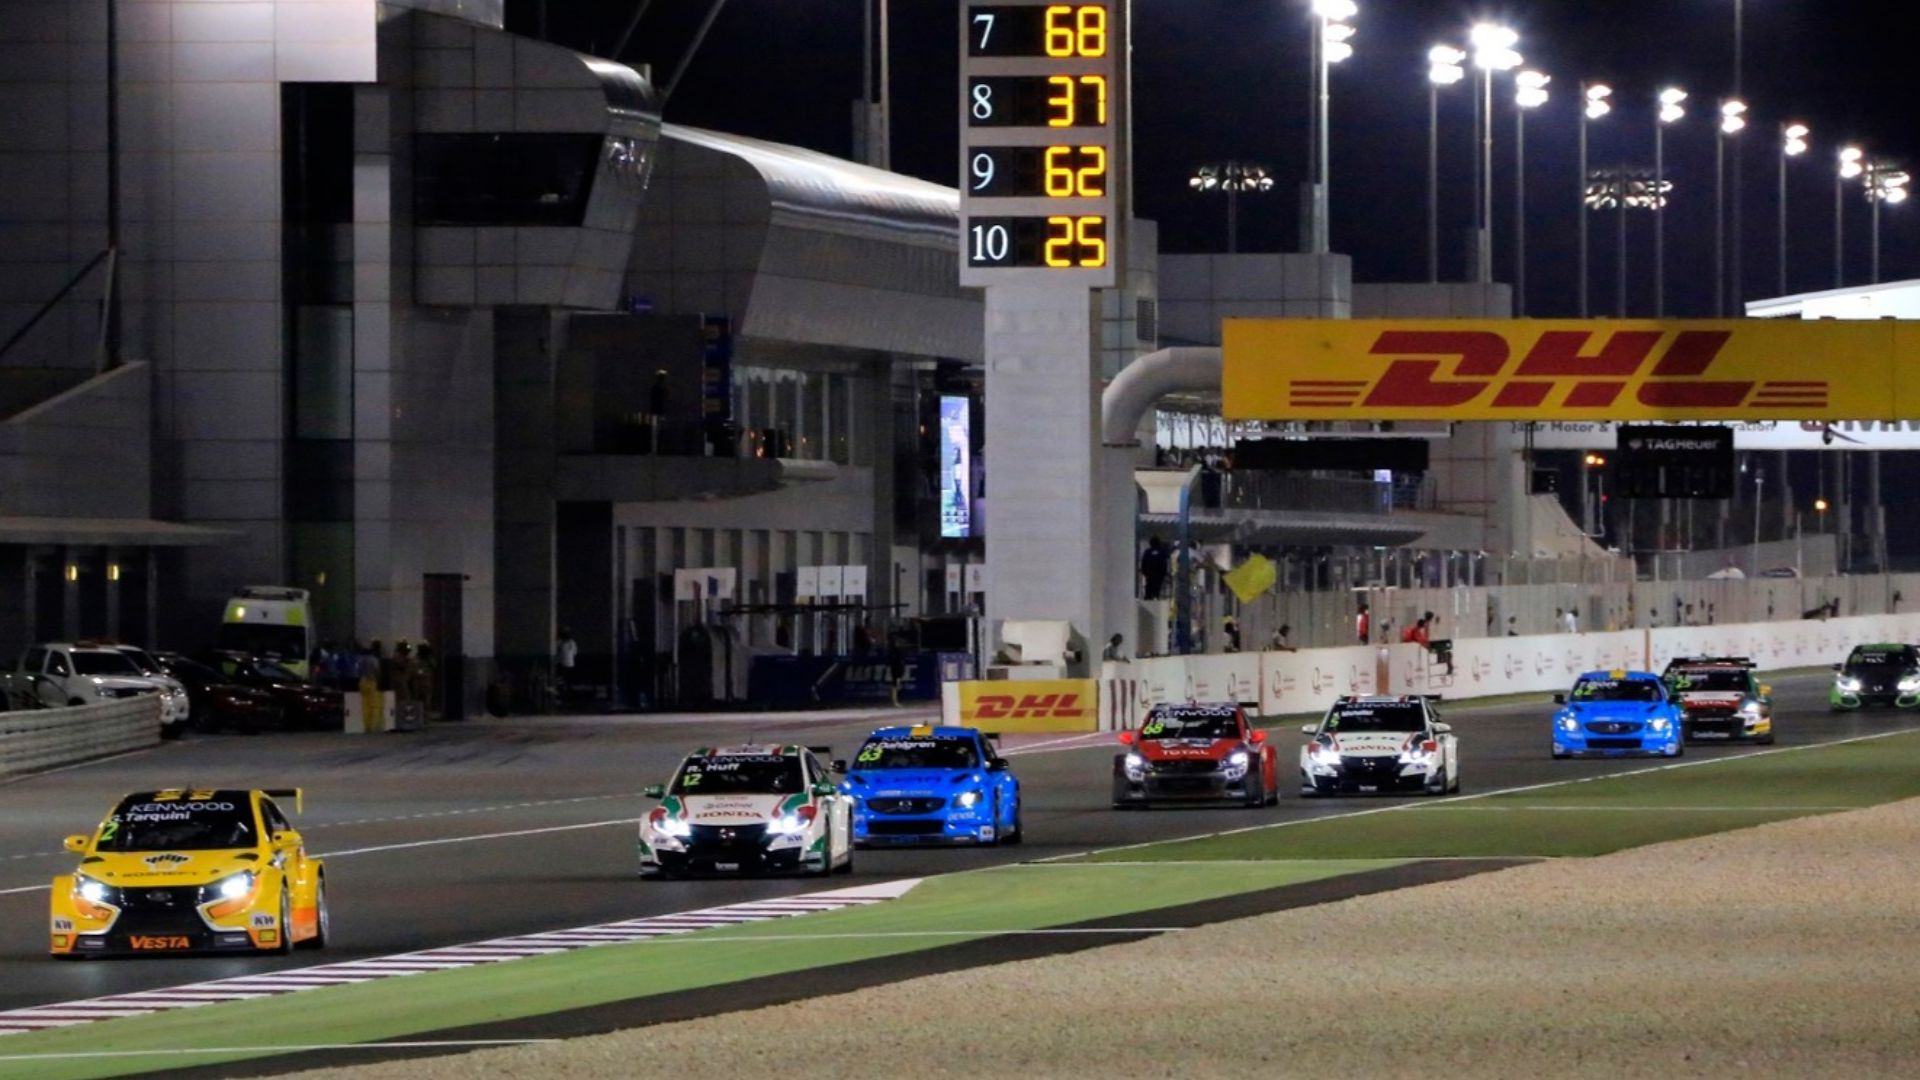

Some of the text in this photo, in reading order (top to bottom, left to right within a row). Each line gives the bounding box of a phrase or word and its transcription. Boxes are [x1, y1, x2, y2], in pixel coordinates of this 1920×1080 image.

[973, 6, 1106, 57] 7 68
[972, 76, 1106, 127] 8 37
[972, 146, 1106, 197] 9 62
[972, 217, 1106, 267] 10 25
[1358, 330, 1758, 408] DHL
[974, 694, 1084, 719] DHL
[1156, 708, 1232, 719] KENWOOD
[858, 747, 884, 762] 63
[1162, 748, 1210, 756] TOTAL
[706, 763, 740, 772] Huff
[683, 773, 702, 787] 12
[130, 801, 235, 813] KENWOOD
[126, 811, 191, 823] Tarquini
[696, 810, 763, 819] HONDA
[100, 821, 120, 841] 2
[253, 914, 275, 926] KW
[129, 935, 191, 949] VESTA
